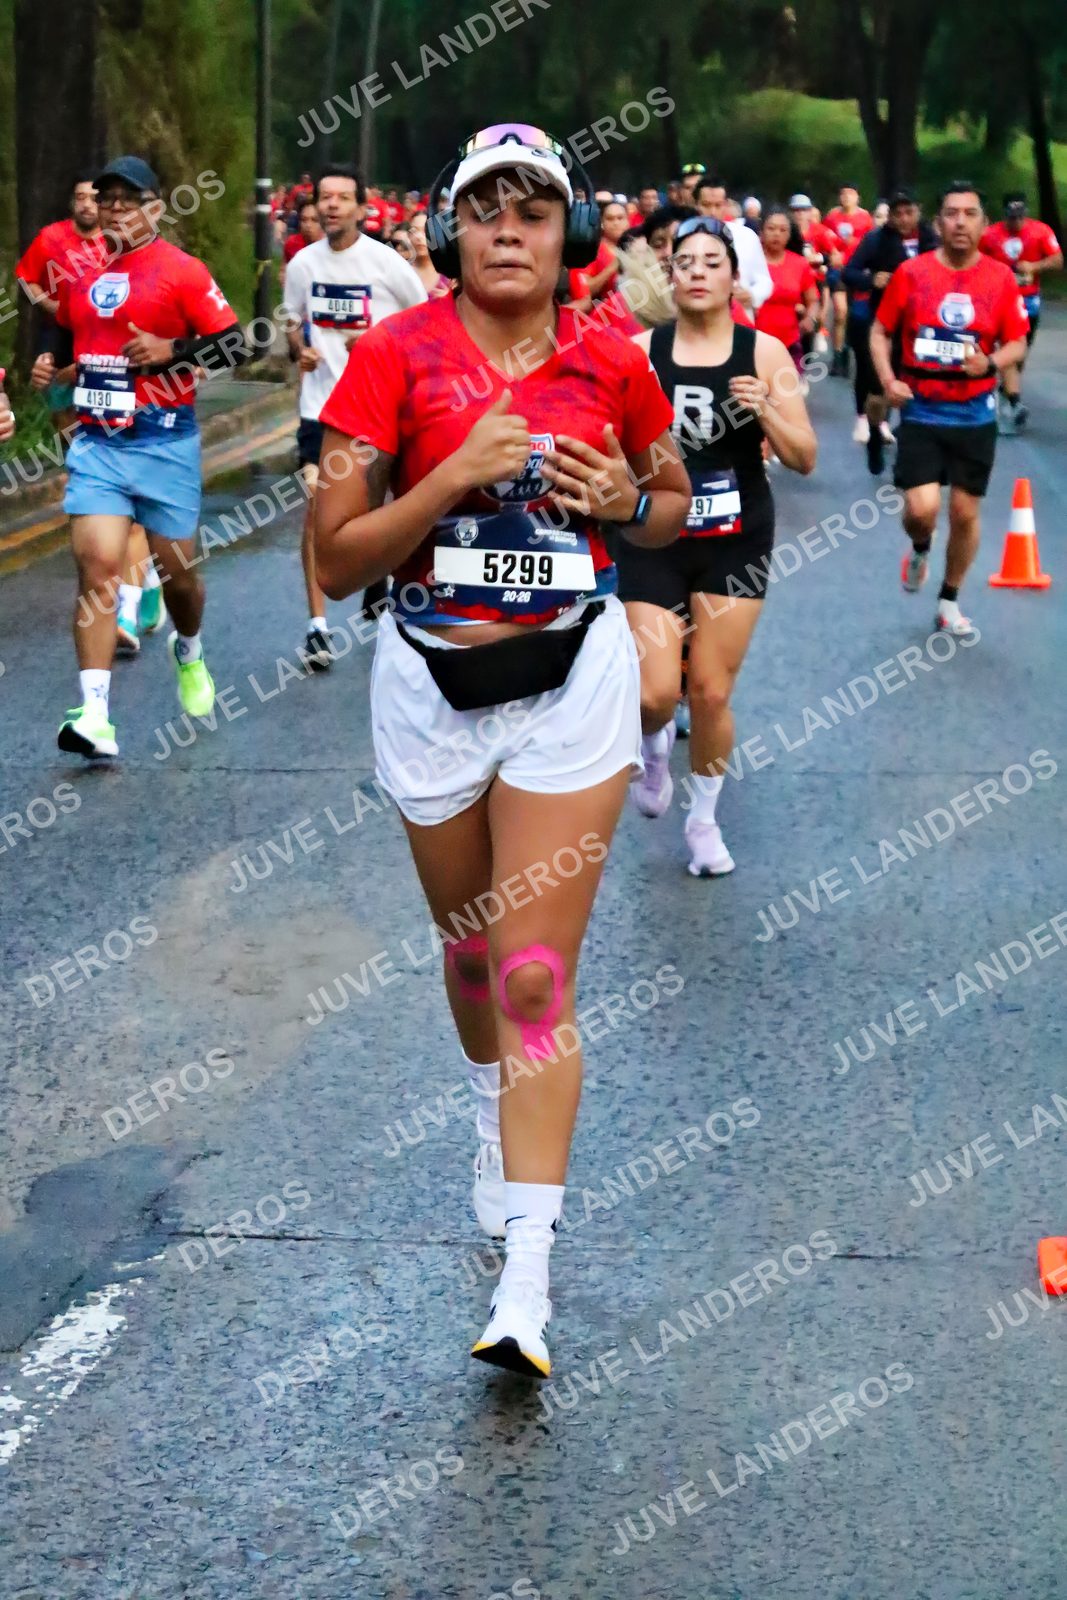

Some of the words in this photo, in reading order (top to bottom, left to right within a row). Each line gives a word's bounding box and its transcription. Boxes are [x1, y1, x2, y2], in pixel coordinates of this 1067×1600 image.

[87, 391, 112, 407] 4130
[672, 384, 714, 440] R
[483, 552, 553, 586] 5299
